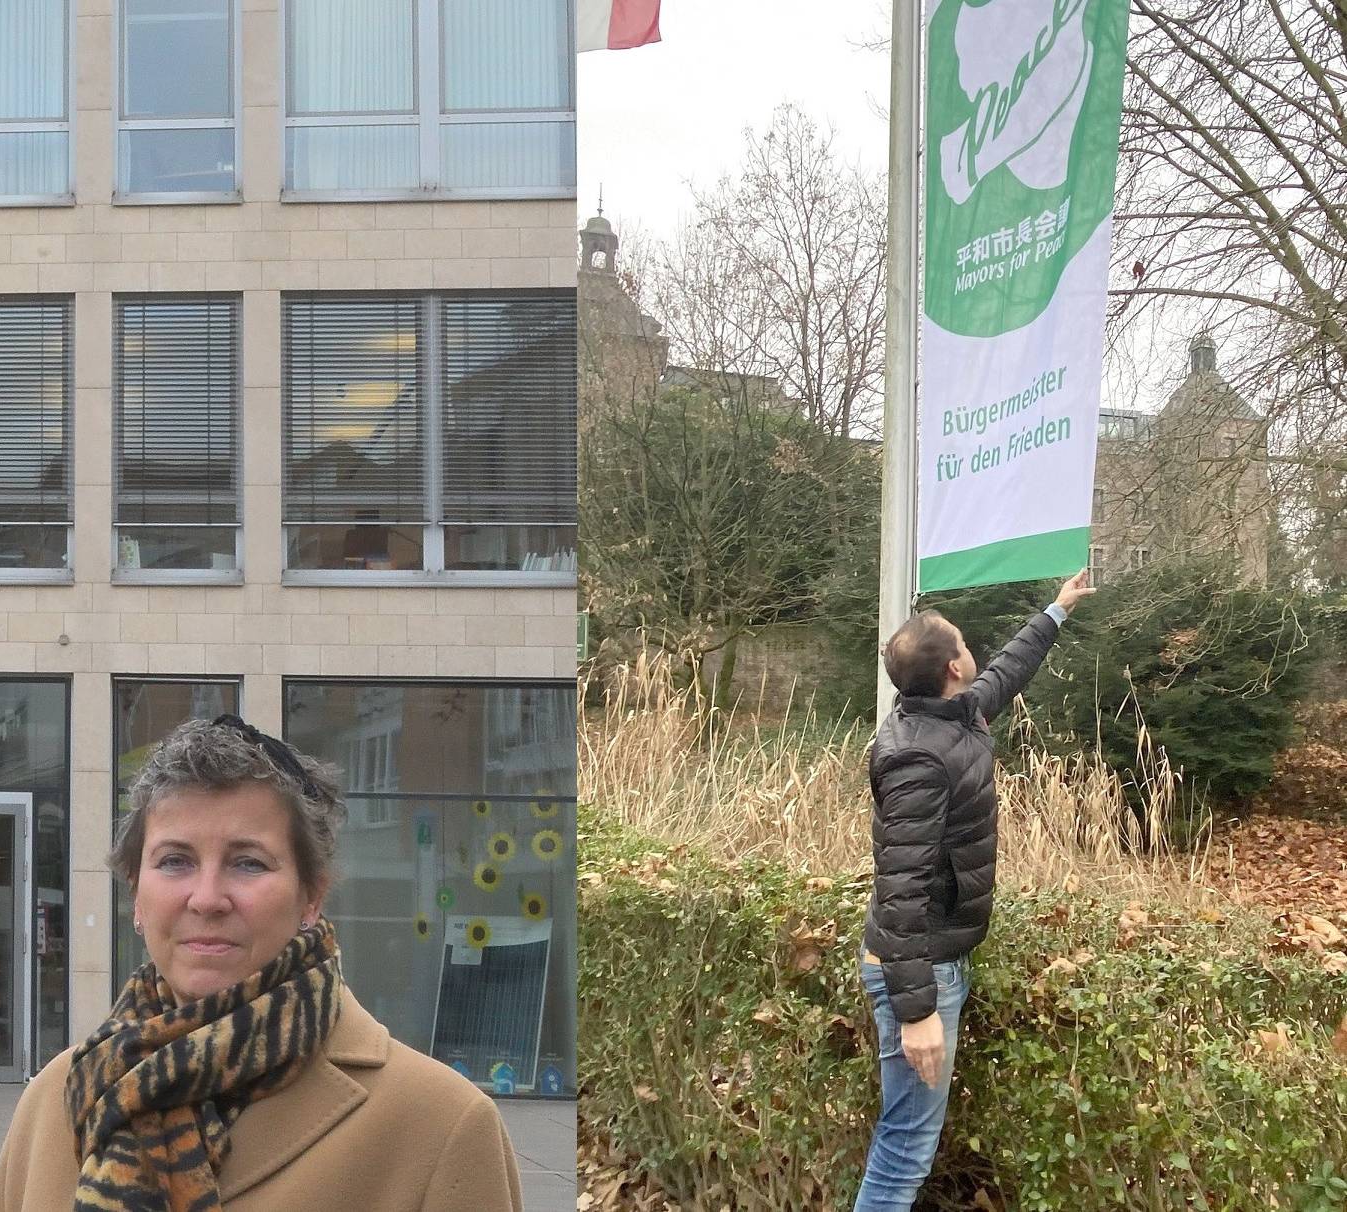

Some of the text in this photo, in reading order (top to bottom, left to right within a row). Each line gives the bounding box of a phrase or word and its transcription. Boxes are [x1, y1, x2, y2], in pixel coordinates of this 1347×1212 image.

[954, 261, 1005, 296] Mayors
[1009, 249, 1031, 278] for
[943, 366, 1067, 437] Bürgermeister
[936, 416, 1071, 482] für den Frieden
